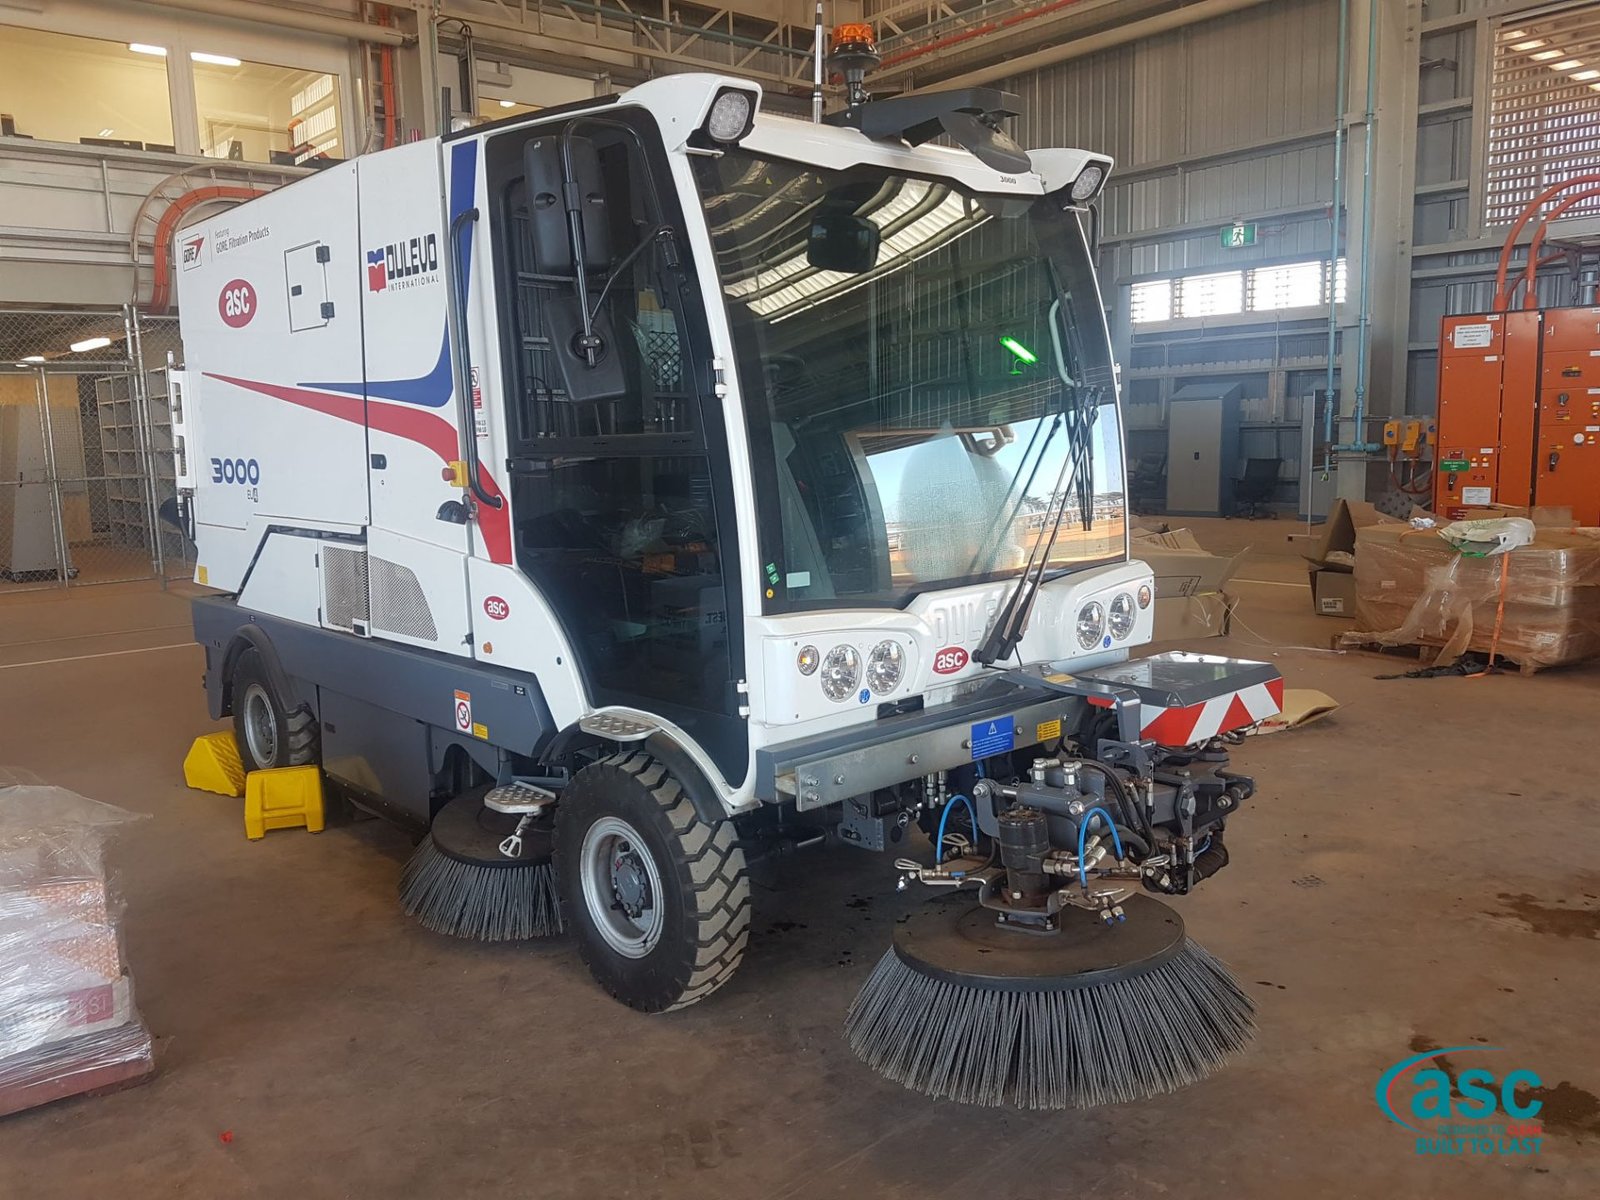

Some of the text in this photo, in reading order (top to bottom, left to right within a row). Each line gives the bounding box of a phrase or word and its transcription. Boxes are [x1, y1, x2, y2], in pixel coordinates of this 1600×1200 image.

[1000, 175, 1016, 185] 3000
[249, 226, 270, 243] Products
[183, 246, 195, 264] GORE
[386, 233, 438, 280] DULEVO
[388, 274, 439, 292] INTERNATIONAL
[225, 287, 250, 317] asc
[211, 457, 260, 486] 3000
[487, 600, 506, 616] asc
[937, 651, 963, 670] asc
